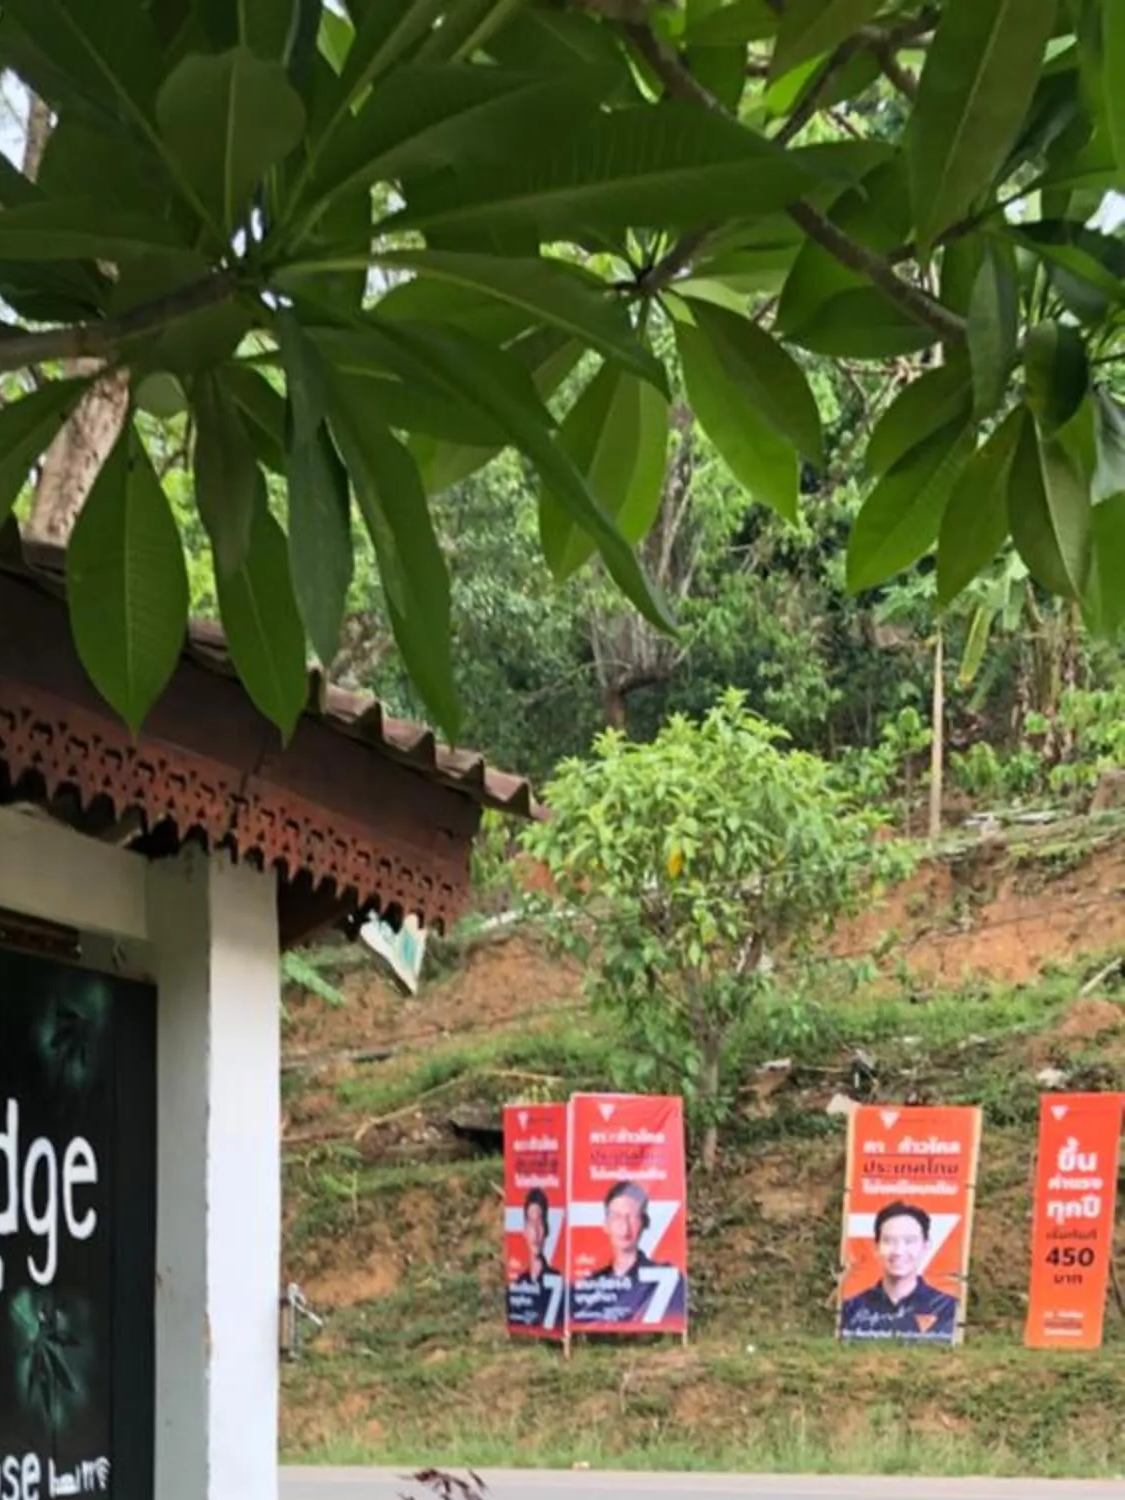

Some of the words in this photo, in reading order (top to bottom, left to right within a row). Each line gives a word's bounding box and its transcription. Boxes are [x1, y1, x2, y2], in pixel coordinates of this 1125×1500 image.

[1047, 1194, 1102, 1226] ทุกปี
[1044, 1246, 1095, 1268] 450
[542, 1273, 563, 1330] 7
[638, 1266, 680, 1324] 7
